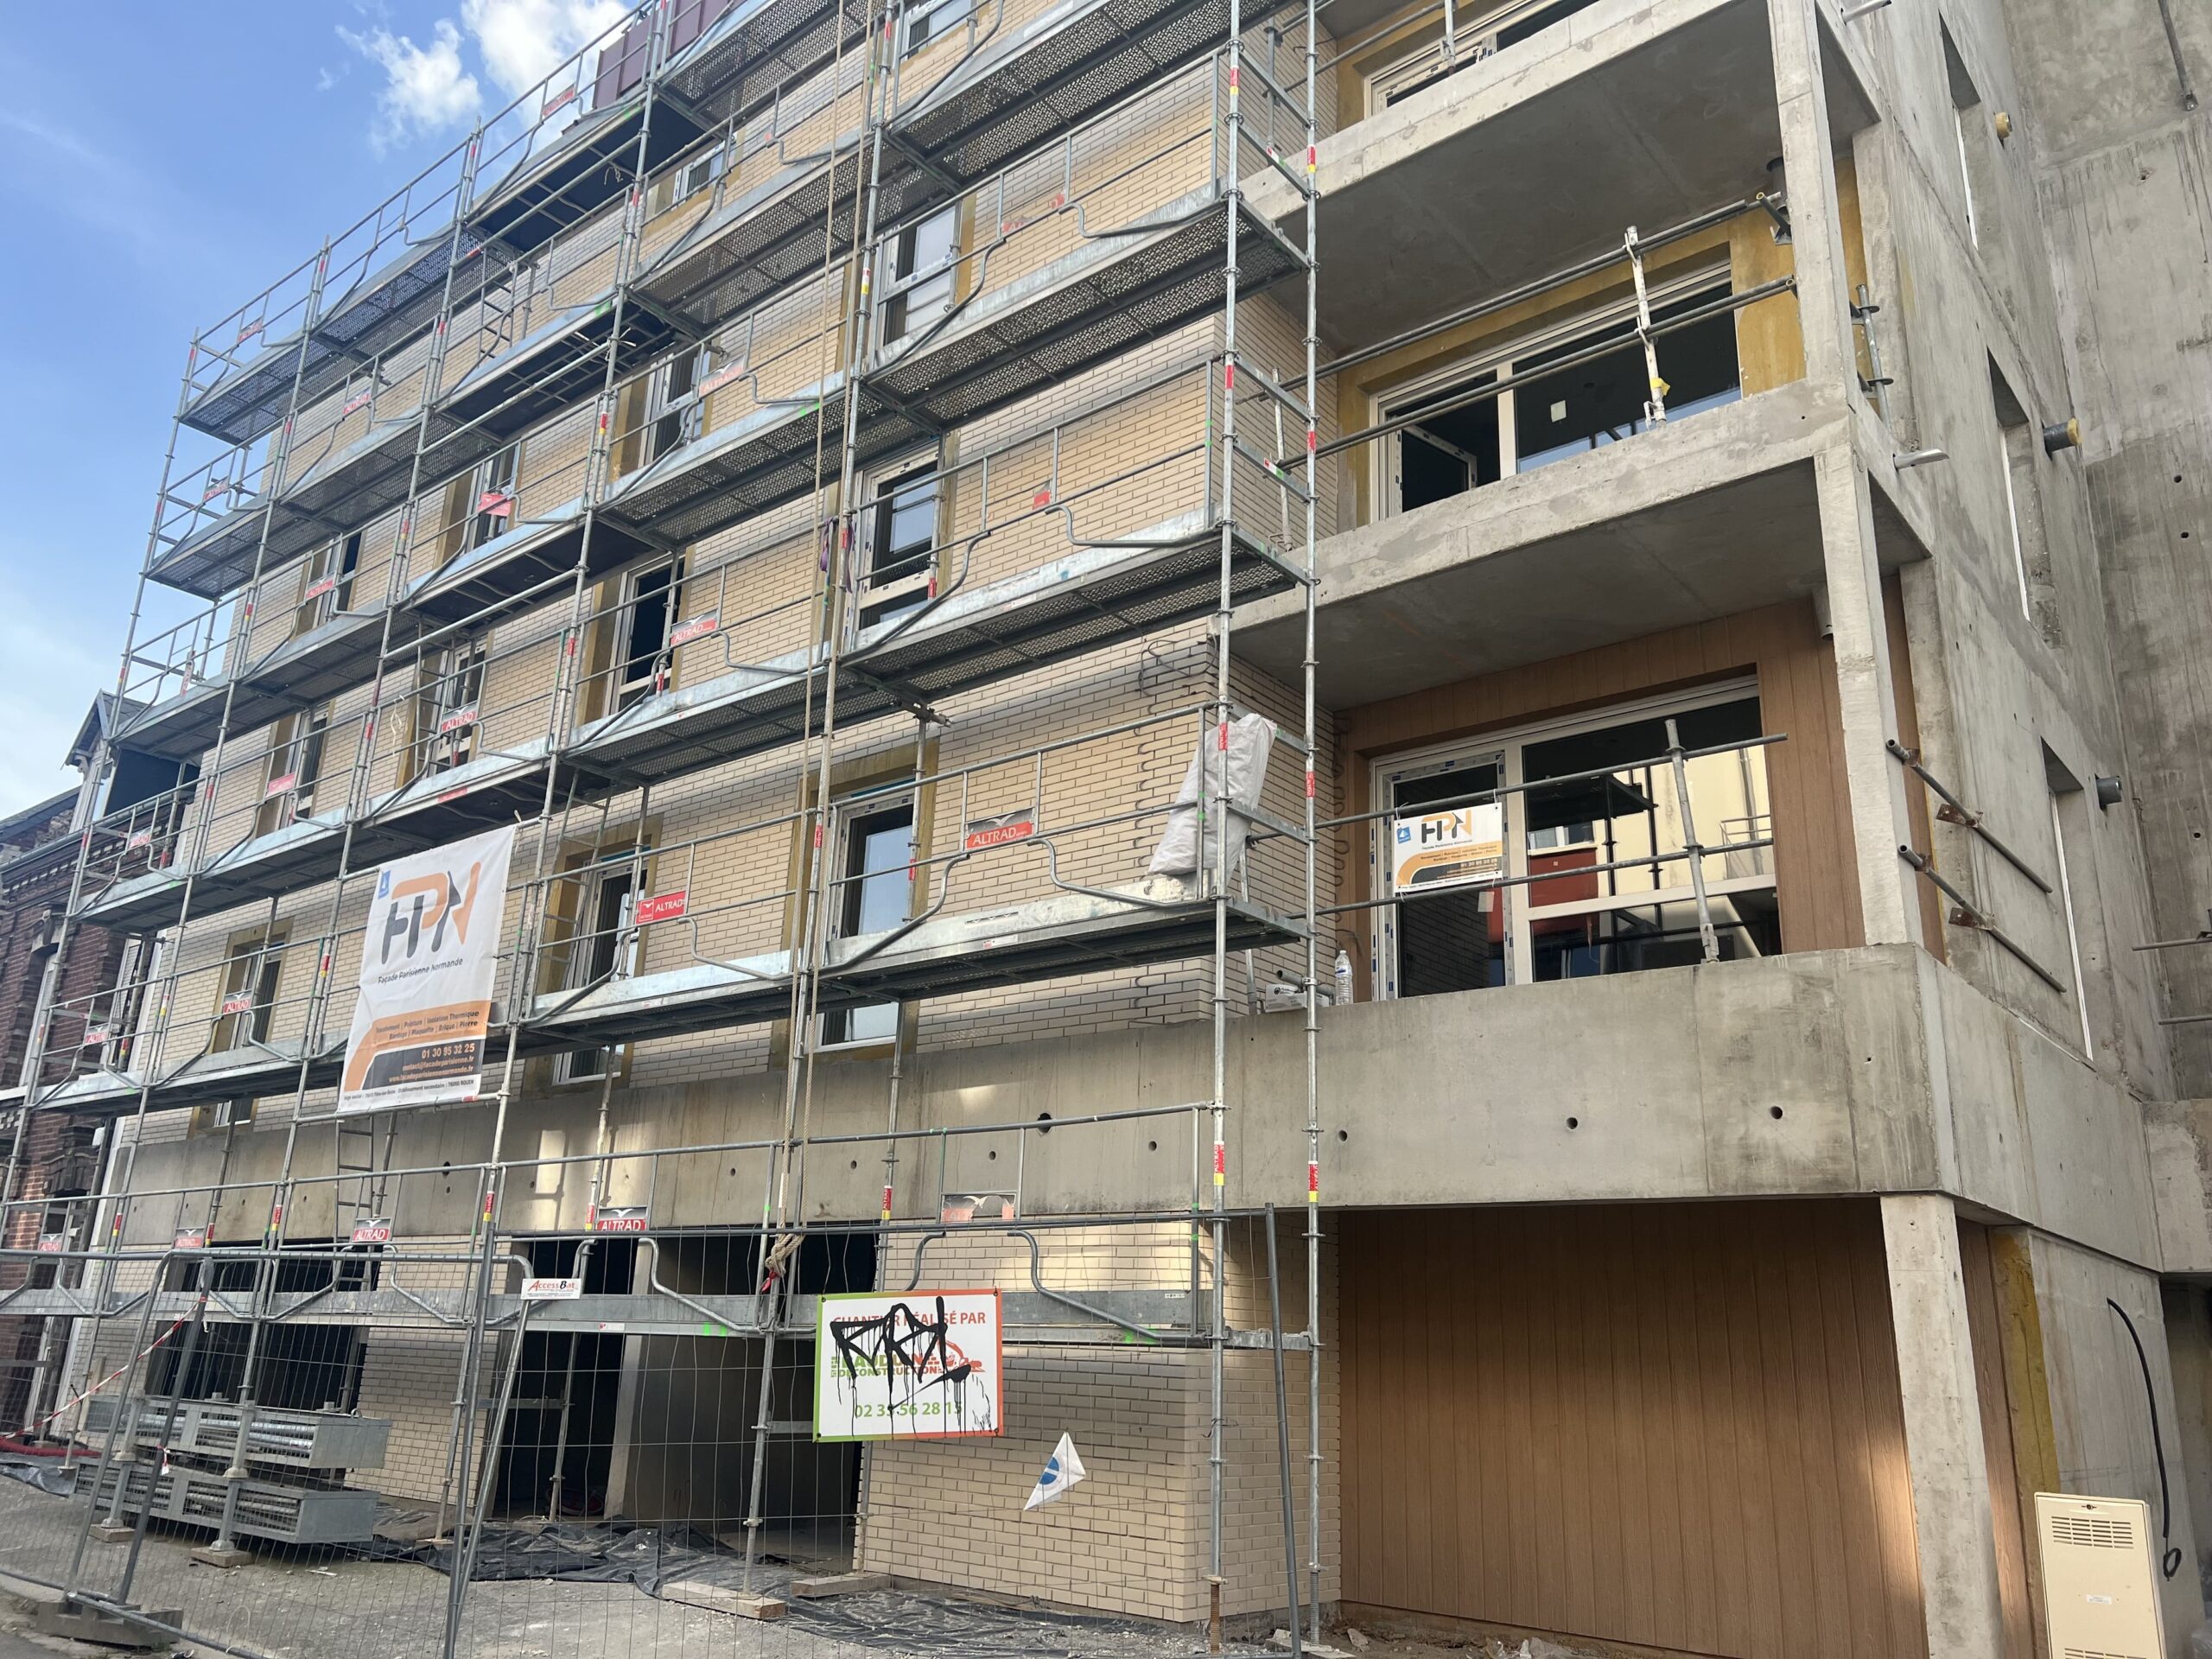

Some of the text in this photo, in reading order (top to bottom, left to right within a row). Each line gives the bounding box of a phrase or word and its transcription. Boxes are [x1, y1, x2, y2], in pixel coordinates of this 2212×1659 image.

[675, 624, 703, 642] ALTRAD
[446, 713, 474, 729] ALTRAD
[973, 827, 1016, 846] ALTRAD
[655, 899, 683, 912] ALTRAD
[378, 957, 463, 985] Façade Parisienne Normande
[227, 1000, 249, 1011] ALTRAD
[449, 1010, 480, 1022] Thermique
[422, 1042, 475, 1059] 01 30 95 32 25
[601, 1219, 641, 1231] ALTRAD
[354, 1228, 385, 1241] ALTRAD
[960, 1312, 986, 1325] PAR
[855, 1404, 873, 1418] 02
[899, 1402, 918, 1415] 56
[922, 1402, 940, 1415] 28
